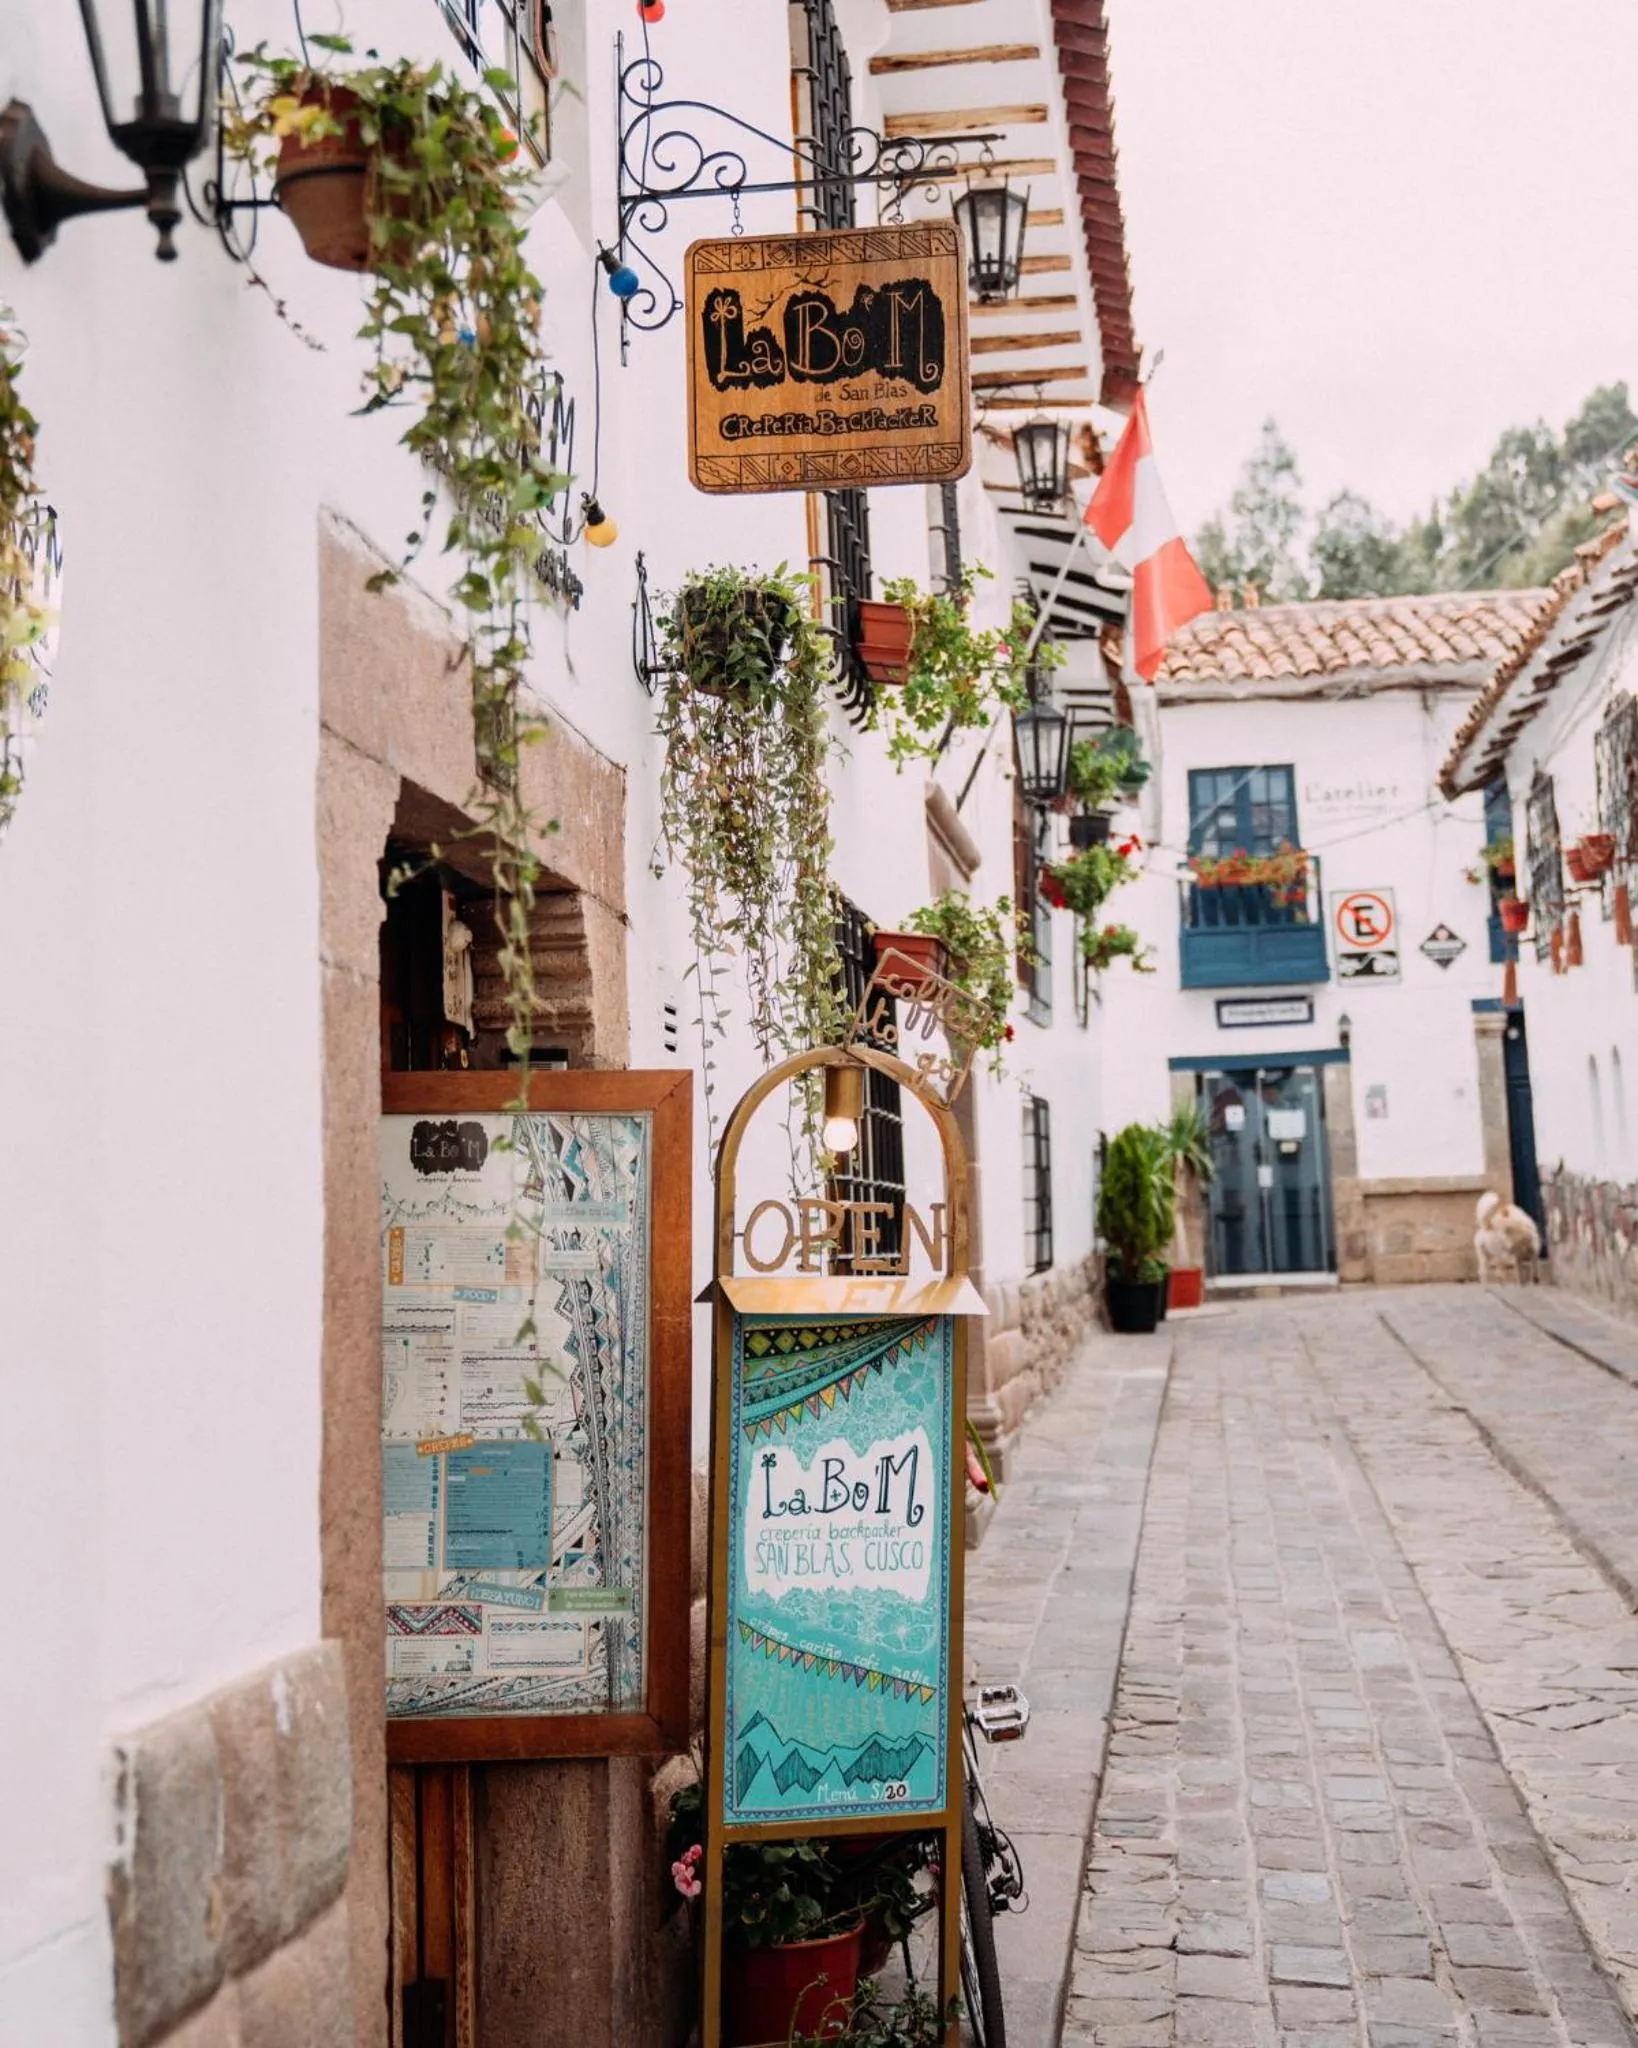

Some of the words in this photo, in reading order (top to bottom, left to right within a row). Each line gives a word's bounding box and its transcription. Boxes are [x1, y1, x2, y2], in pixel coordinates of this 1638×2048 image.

[710, 296, 784, 383] La
[814, 386, 832, 402] de
[839, 384, 869, 401] San
[874, 382, 908, 400] Blas
[1354, 905, 1376, 937] E
[867, 997, 898, 1043] to
[743, 1198, 947, 1273] OPEN
[761, 1452, 812, 1518] La
[755, 1542, 790, 1581] SAN
[864, 1540, 924, 1572] CUSCO
